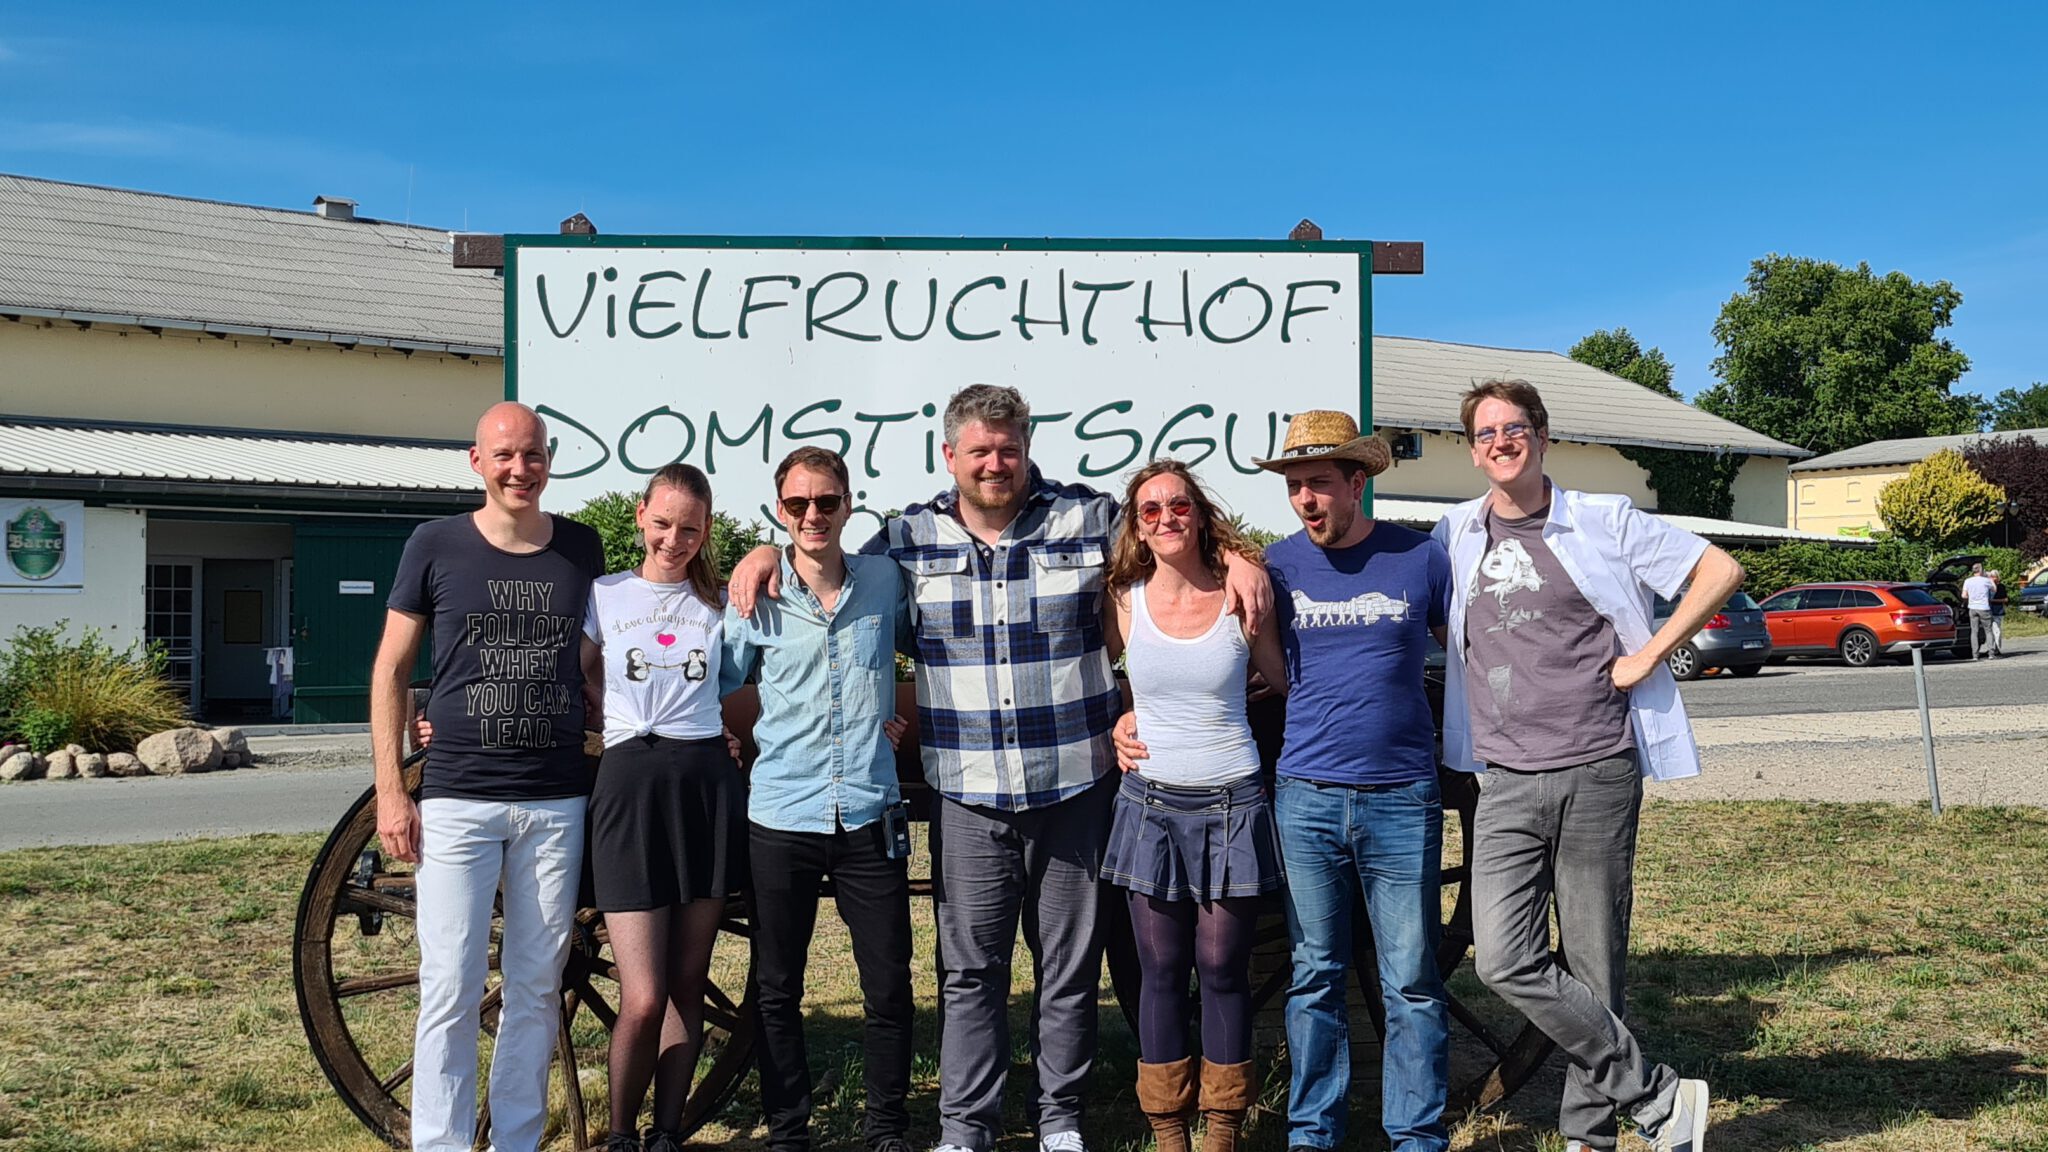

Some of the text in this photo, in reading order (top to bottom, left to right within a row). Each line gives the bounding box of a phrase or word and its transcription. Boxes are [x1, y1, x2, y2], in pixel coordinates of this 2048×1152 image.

[8, 534, 63, 549] Barre
[487, 579, 554, 612] WHY
[466, 612, 575, 647] FOLLOW
[612, 607, 713, 635] Love always wins
[480, 648, 558, 681] WHEN
[466, 682, 570, 716] YOU CAN
[480, 717, 557, 749] LEAD.
